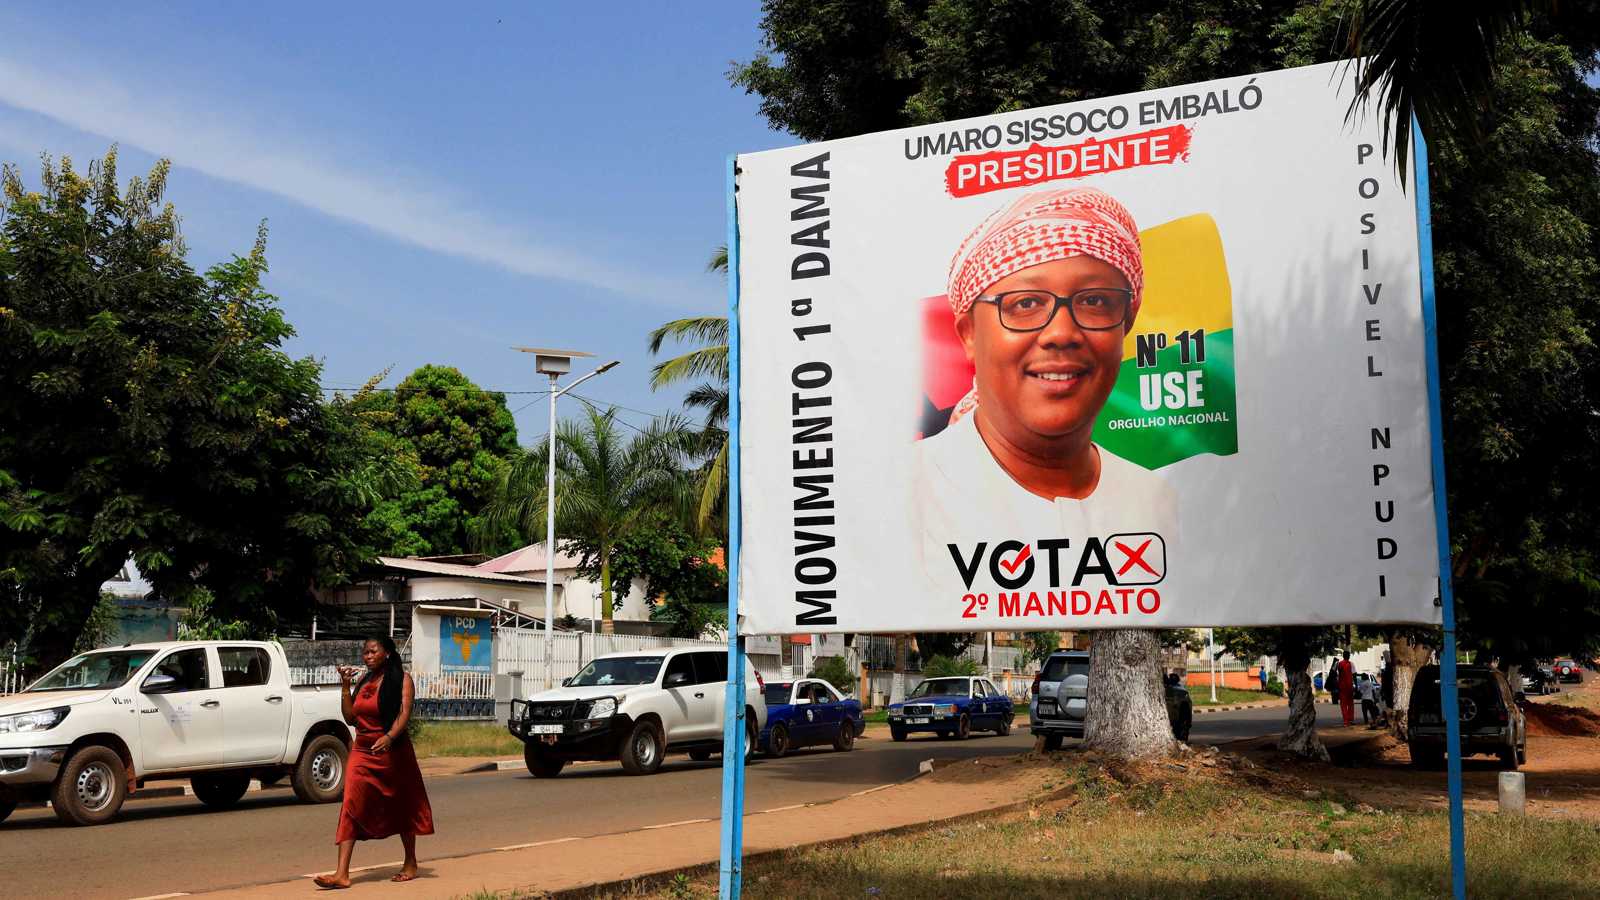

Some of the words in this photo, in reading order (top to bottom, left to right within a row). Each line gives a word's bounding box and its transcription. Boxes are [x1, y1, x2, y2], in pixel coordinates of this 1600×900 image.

[904, 125, 1002, 161] UMARO
[1006, 105, 1129, 145] SISSOCO
[1139, 78, 1264, 126] EMBALÓ
[958, 134, 1171, 189] PRESIDENTE
[790, 151, 831, 281] DAMA
[1175, 328, 1206, 365] 11
[1139, 370, 1206, 412] USE
[1357, 143, 1383, 378] POSIVEL
[1370, 426, 1399, 599] NPUDI
[1108, 416, 1166, 430] ORGULHO
[1168, 411, 1230, 426] NACIONAL
[791, 361, 838, 626] MOVIMENTO
[455, 617, 475, 628] PCD
[997, 587, 1161, 618] MANDATO
